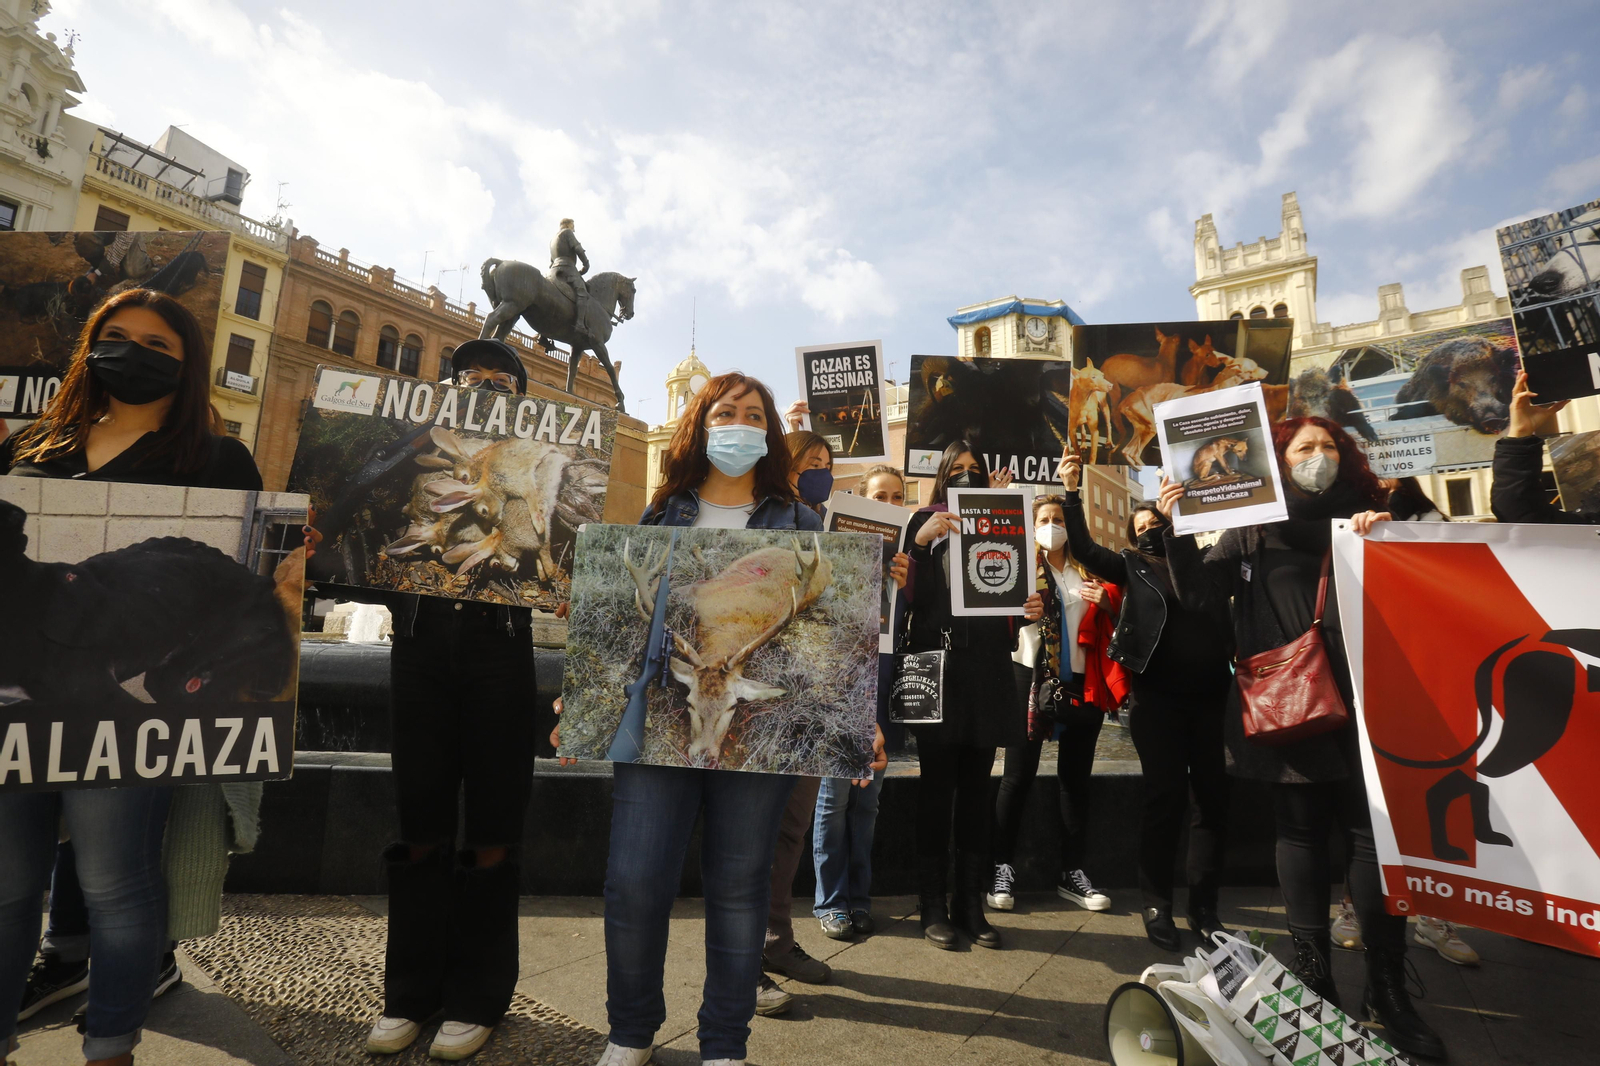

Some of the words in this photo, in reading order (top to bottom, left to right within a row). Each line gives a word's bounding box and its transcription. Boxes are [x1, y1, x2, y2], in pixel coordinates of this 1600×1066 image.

[811, 356, 851, 374] CAZAR
[855, 354, 871, 370] ES
[811, 370, 874, 390] ASESINAR
[21, 376, 61, 414] NO
[320, 394, 345, 405] Galgos
[346, 398, 358, 407] del
[358, 399, 371, 408] Sur
[381, 379, 434, 423] NO
[434, 387, 458, 427] A
[463, 391, 507, 436] LA
[514, 400, 601, 450] CAZA
[1361, 434, 1431, 448] TRANSPORTE
[1378, 446, 1432, 460] ANIMALES
[1382, 461, 1414, 472] VIVOS
[1187, 479, 1262, 497] #RespetoVidaAnimal
[1202, 491, 1249, 503] #NoALaCaza
[853, 521, 868, 529] mundo
[875, 526, 894, 534] crueldad
[992, 525, 1025, 535] CAZA
[0, 722, 33, 785] A
[47, 720, 122, 783] LA
[135, 716, 280, 779] CAZA
[1464, 887, 1534, 916] más
